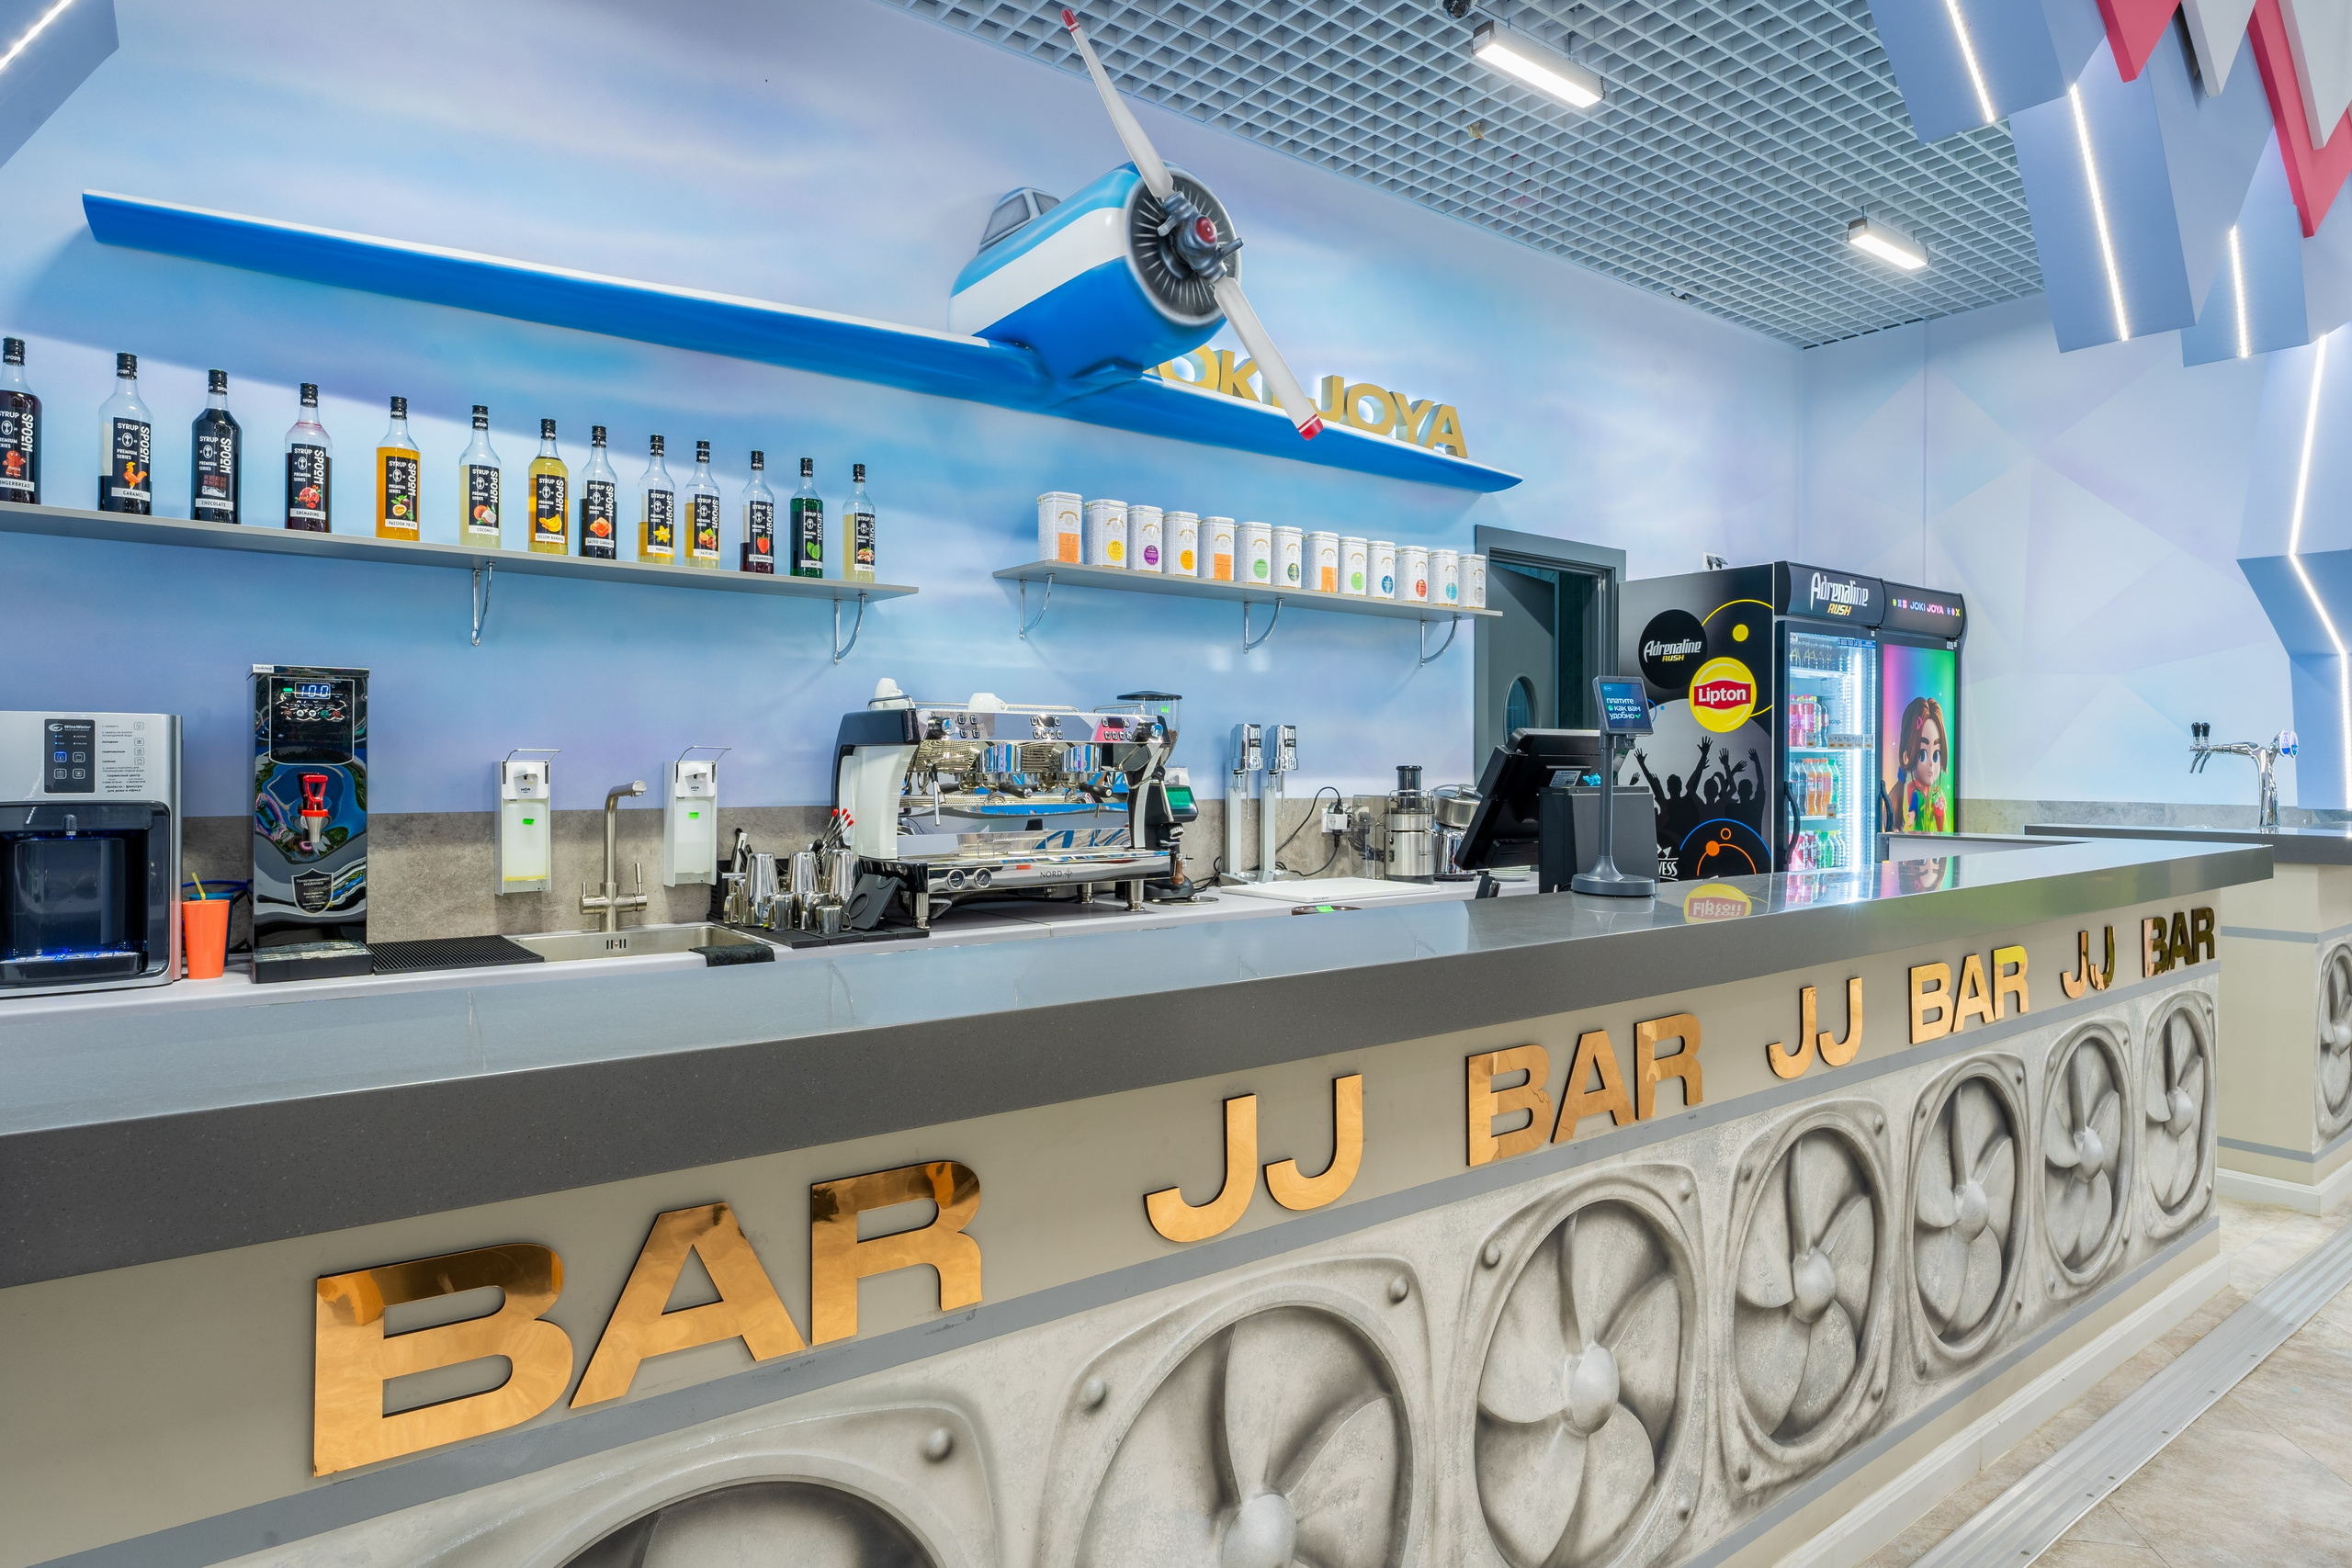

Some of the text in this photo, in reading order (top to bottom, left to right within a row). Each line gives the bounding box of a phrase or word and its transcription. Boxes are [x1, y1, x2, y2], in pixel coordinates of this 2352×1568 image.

[1156, 344, 1468, 458] OK JOYA
[21, 412, 34, 453] SPOOM
[117, 422, 140, 431] SYRUP
[140, 425, 151, 465] SPOOM
[199, 435, 220, 444] SYRUP
[117, 448, 137, 457] PREMIUM
[220, 437, 232, 474] SPOOM
[294, 447, 312, 456] SYRUP
[314, 449, 324, 485] SPOOM
[471, 468, 490, 476] SYRUP
[0, 480, 31, 489] INGERBREAD
[407, 462, 417, 497] SPOOM
[490, 469, 499, 503] SPOOM
[556, 479, 564, 512] SPOOM
[201, 500, 227, 508] CHOCOLATE
[1811, 572, 1869, 611] Adrenaline
[1827, 604, 1852, 616] RUSH
[1909, 601, 1944, 615] JOKI JOYA
[1644, 638, 1702, 662] Adrenaline
[1662, 654, 1685, 662] RUSH
[301, 684, 330, 697] 100
[1698, 687, 1747, 705] Lipton
[1609, 711, 1635, 720] удобно
[1040, 870, 1062, 878] NORD
[313, 907, 2216, 1478] BAR JJ BAR JJ BAR JJ BAR
